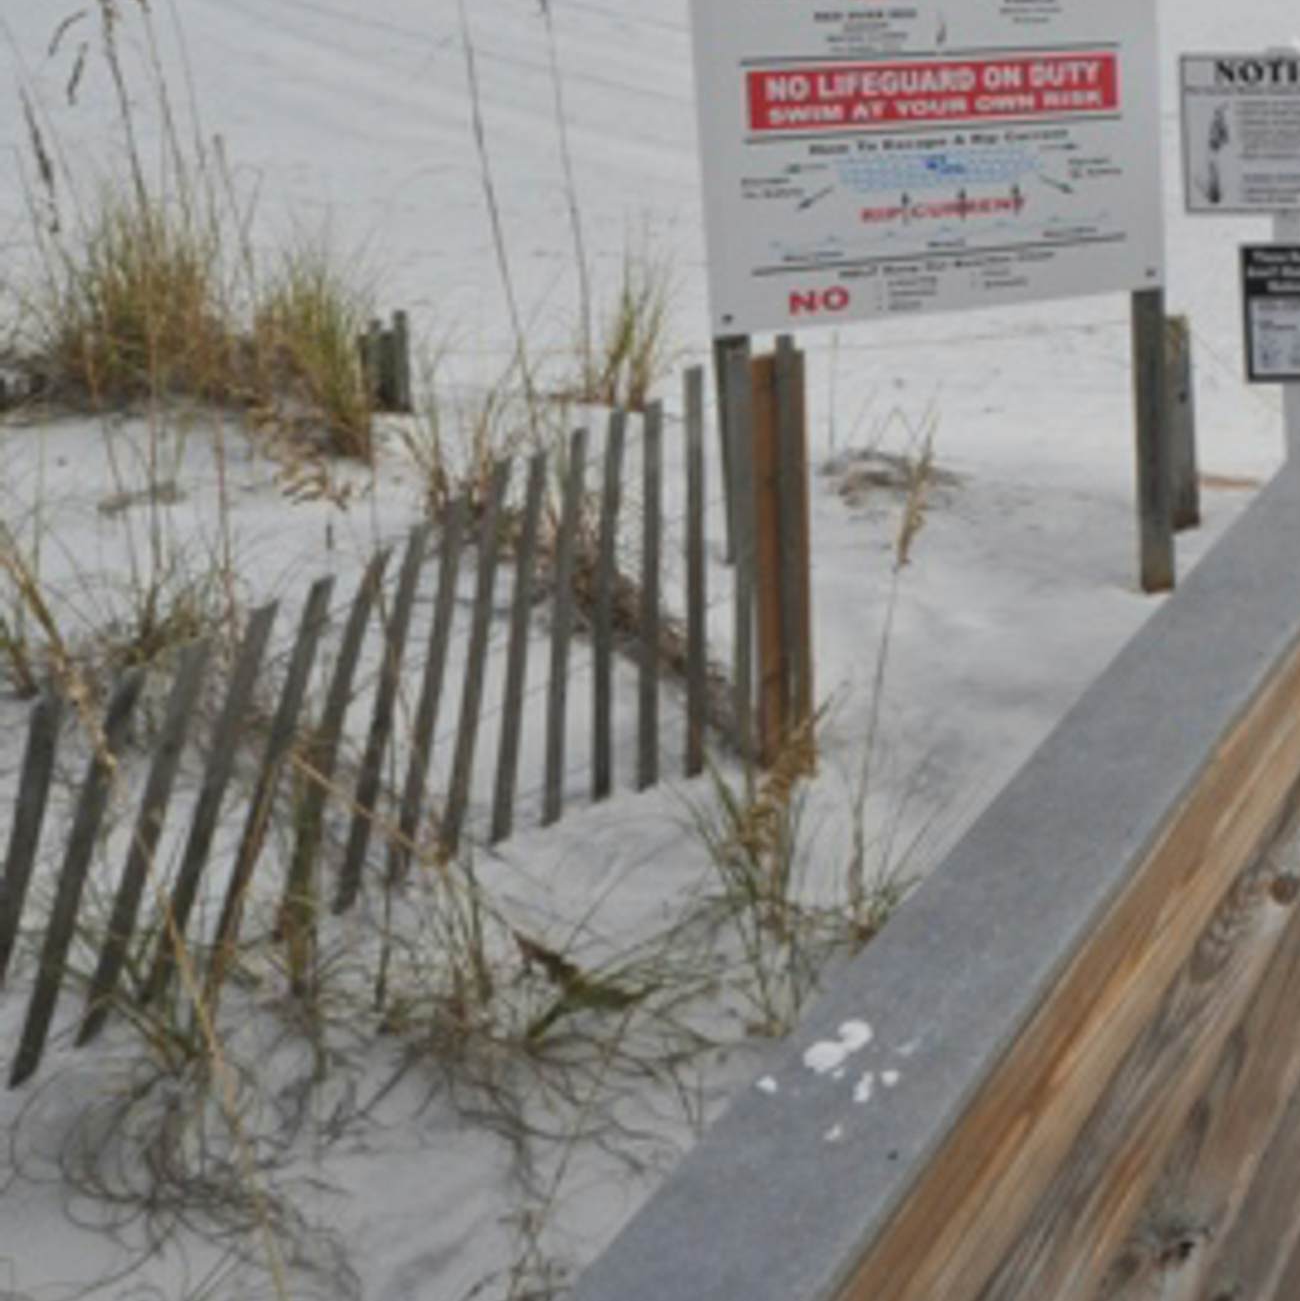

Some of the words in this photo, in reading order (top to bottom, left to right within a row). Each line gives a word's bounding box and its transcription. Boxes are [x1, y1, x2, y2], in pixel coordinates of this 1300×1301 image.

[764, 74, 812, 102] NO
[816, 65, 977, 99] LIFEGUARD
[983, 64, 1023, 90] ON
[1027, 59, 1101, 88] DUTY
[768, 104, 844, 125] SWIM
[851, 101, 887, 120] AT
[895, 97, 968, 118] YOUR
[974, 93, 1035, 112] OWN
[1042, 89, 1102, 109] RISK
[858, 205, 902, 225] RIP
[910, 195, 1025, 221] CURRENT
[788, 286, 850, 317] NO
